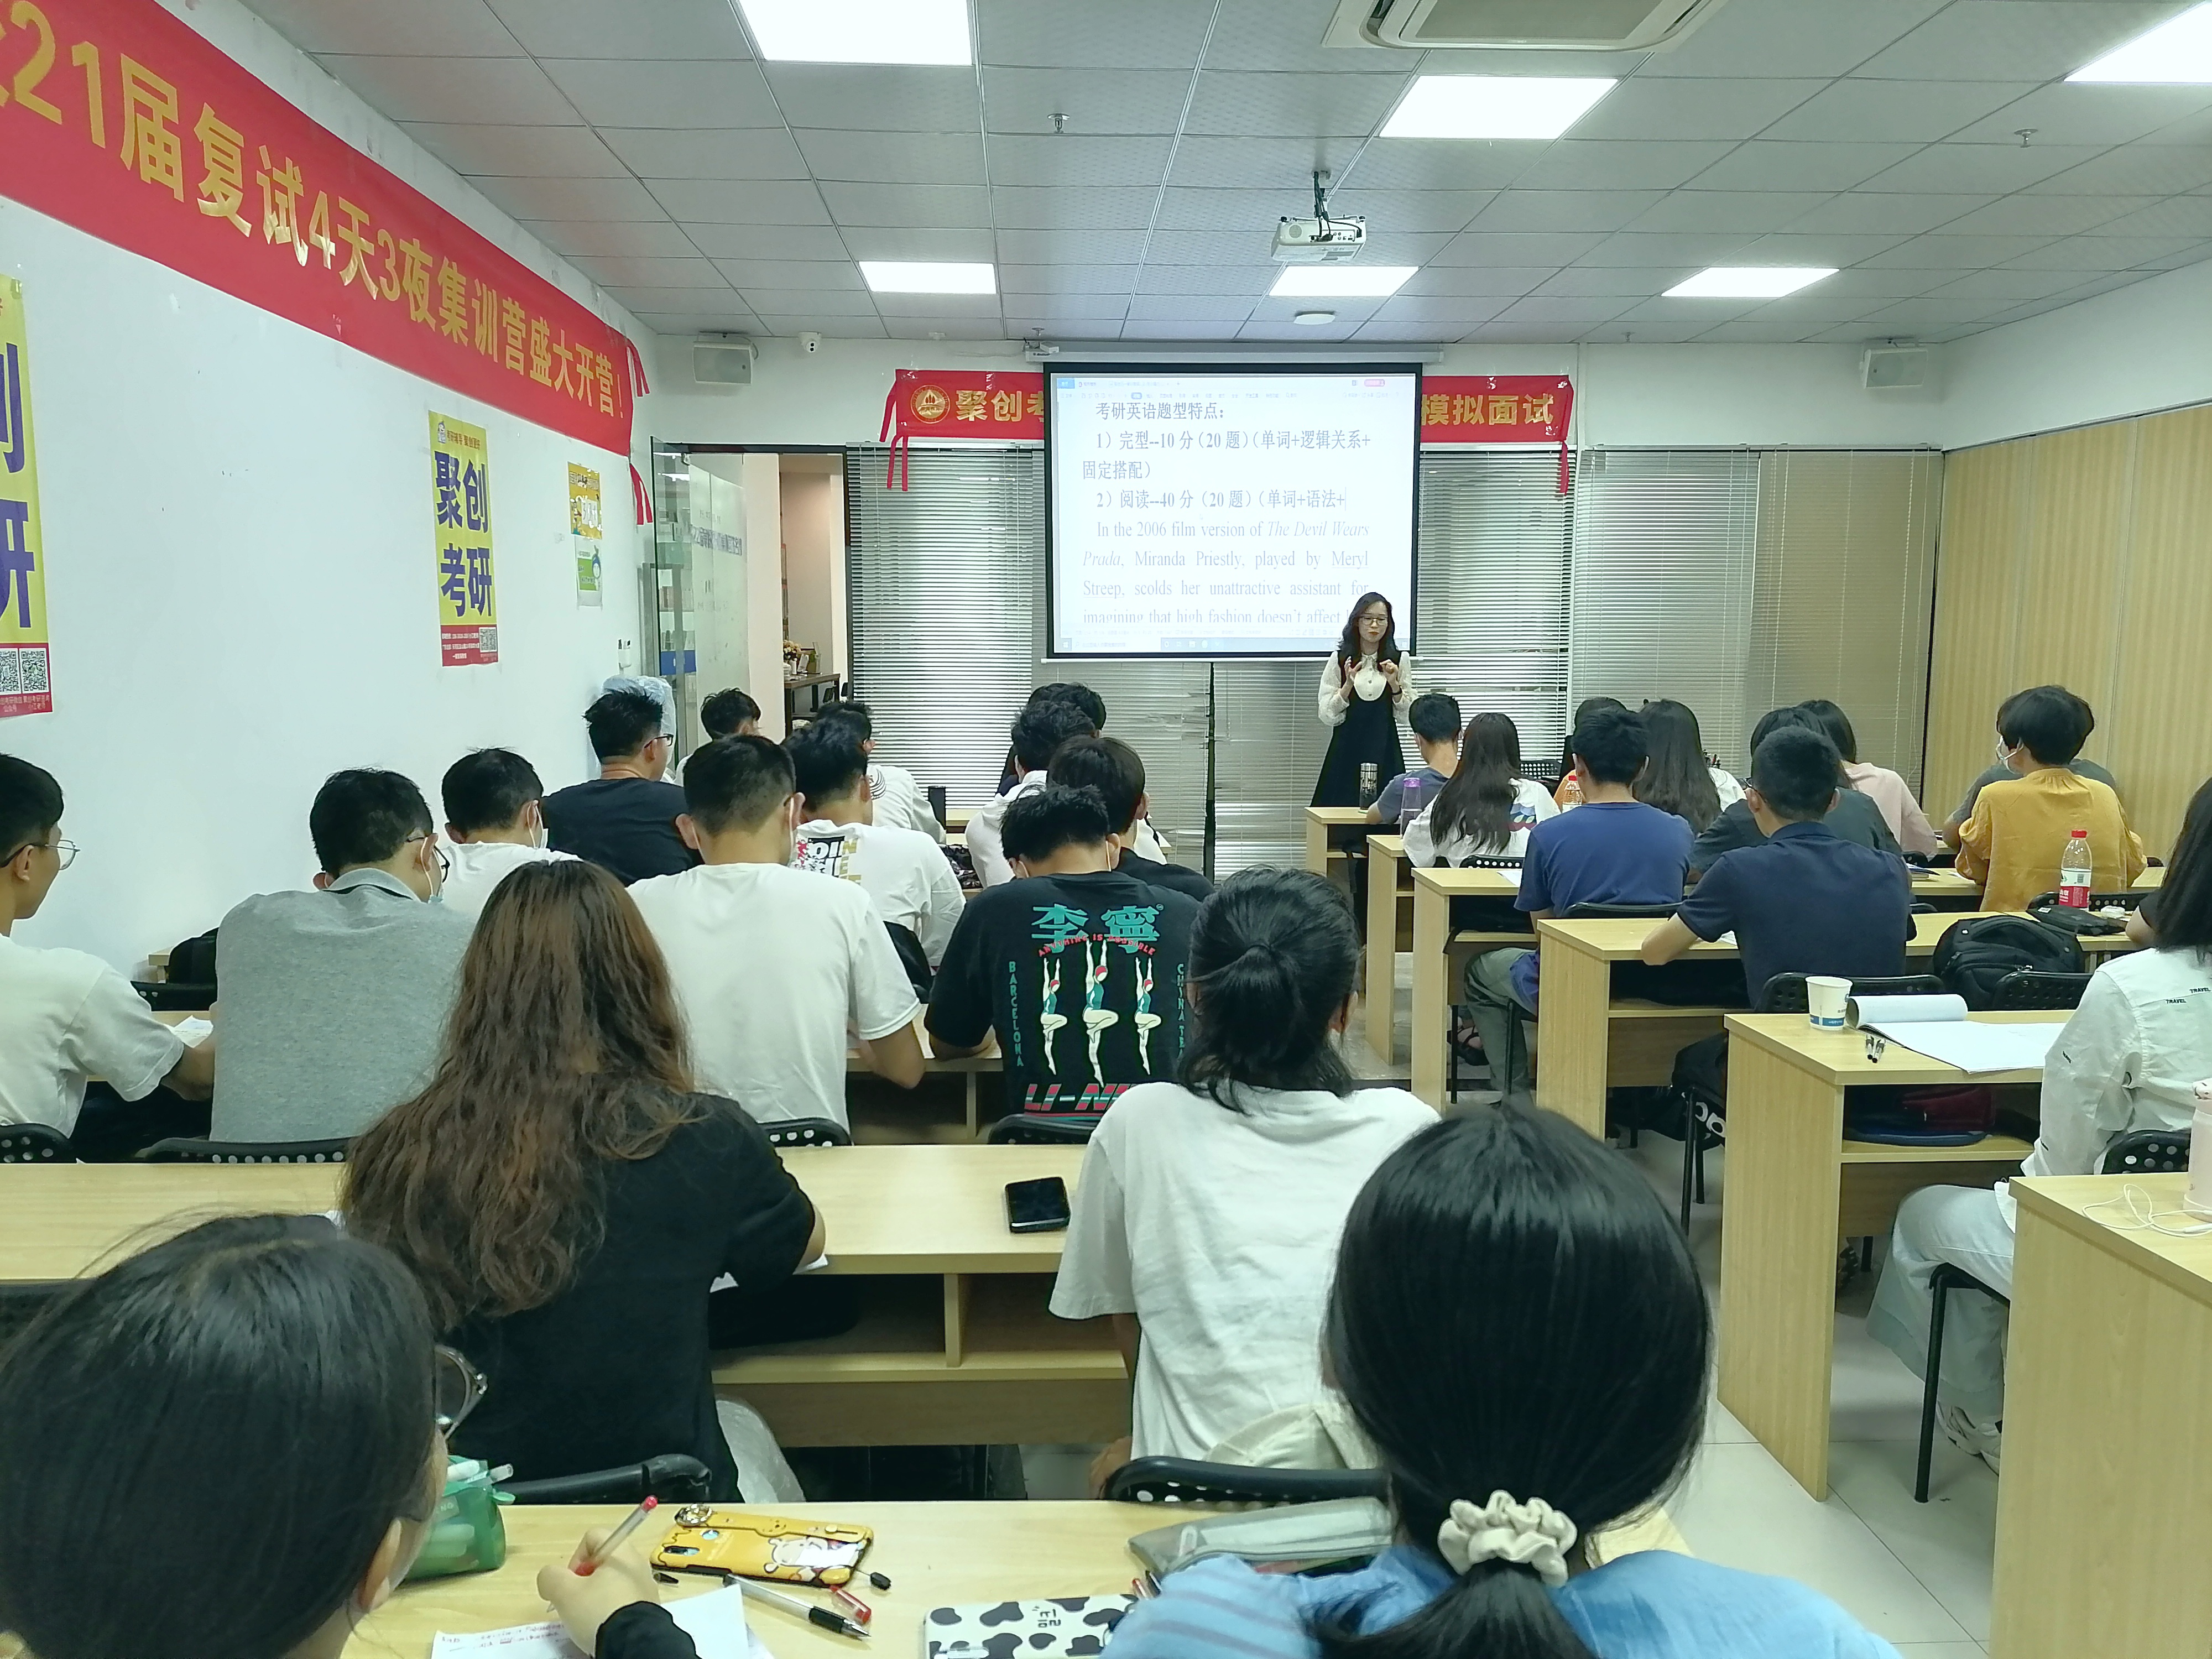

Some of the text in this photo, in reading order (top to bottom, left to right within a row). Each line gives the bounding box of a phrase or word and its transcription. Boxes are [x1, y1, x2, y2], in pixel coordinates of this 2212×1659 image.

[0, 0, 624, 419] 21届复试4天3夜集训营盛大开营！
[1095, 402, 1224, 420] 考研英语题型特点：
[1421, 393, 1554, 426] 模拟面试
[1083, 460, 1151, 480] 固定搭配）
[434, 451, 489, 533] 聚创
[1097, 521, 1370, 537] In the 2006 film version of The Devil Wears
[1083, 550, 1369, 570] Prada, Miranda Priestly, played by Meryl
[440, 542, 492, 617] 考研
[1083, 580, 1369, 599] Streep, scolds her unattractive assistant for
[1083, 609, 1144, 623] imagining
[1149, 609, 1172, 623] that
[1177, 608, 1203, 623] high
[1208, 608, 1252, 623] fashion
[1257, 608, 1302, 623] doesn’t
[1306, 608, 1342, 623] affect
[1038, 935, 1089, 957] ANYTHING
[1107, 936, 1156, 956] POSSIBLE
[1177, 964, 1185, 1021] CHINA
[1009, 961, 1024, 1066] BARCELONA
